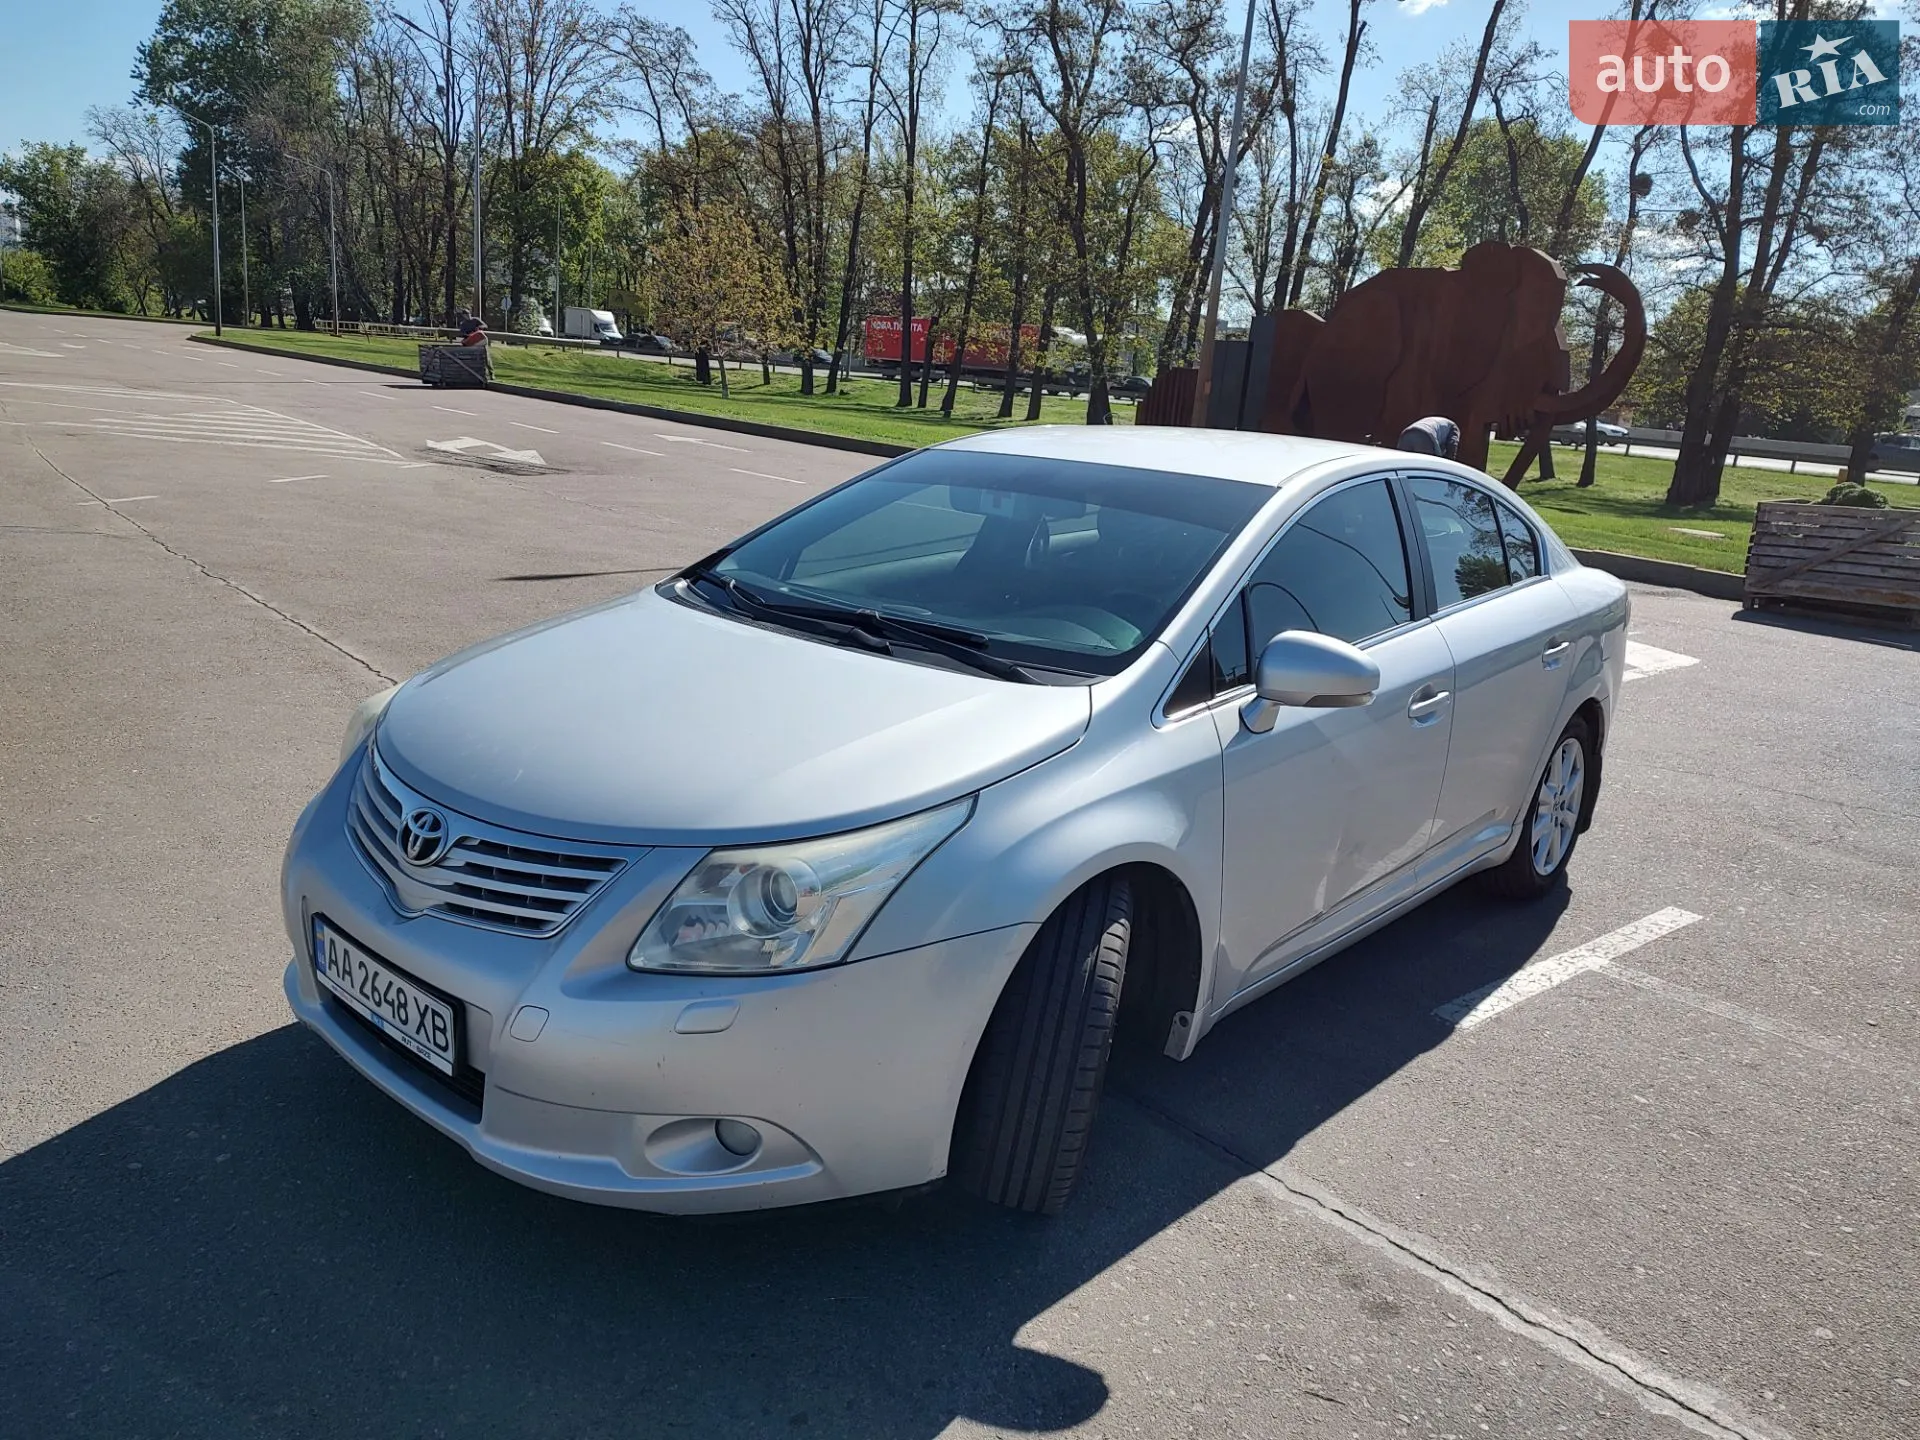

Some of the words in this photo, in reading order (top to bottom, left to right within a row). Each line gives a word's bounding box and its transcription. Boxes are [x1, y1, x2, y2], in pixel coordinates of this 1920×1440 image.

[327, 937, 355, 989] AA
[358, 960, 410, 1027] 2648
[413, 996, 450, 1054] XB
